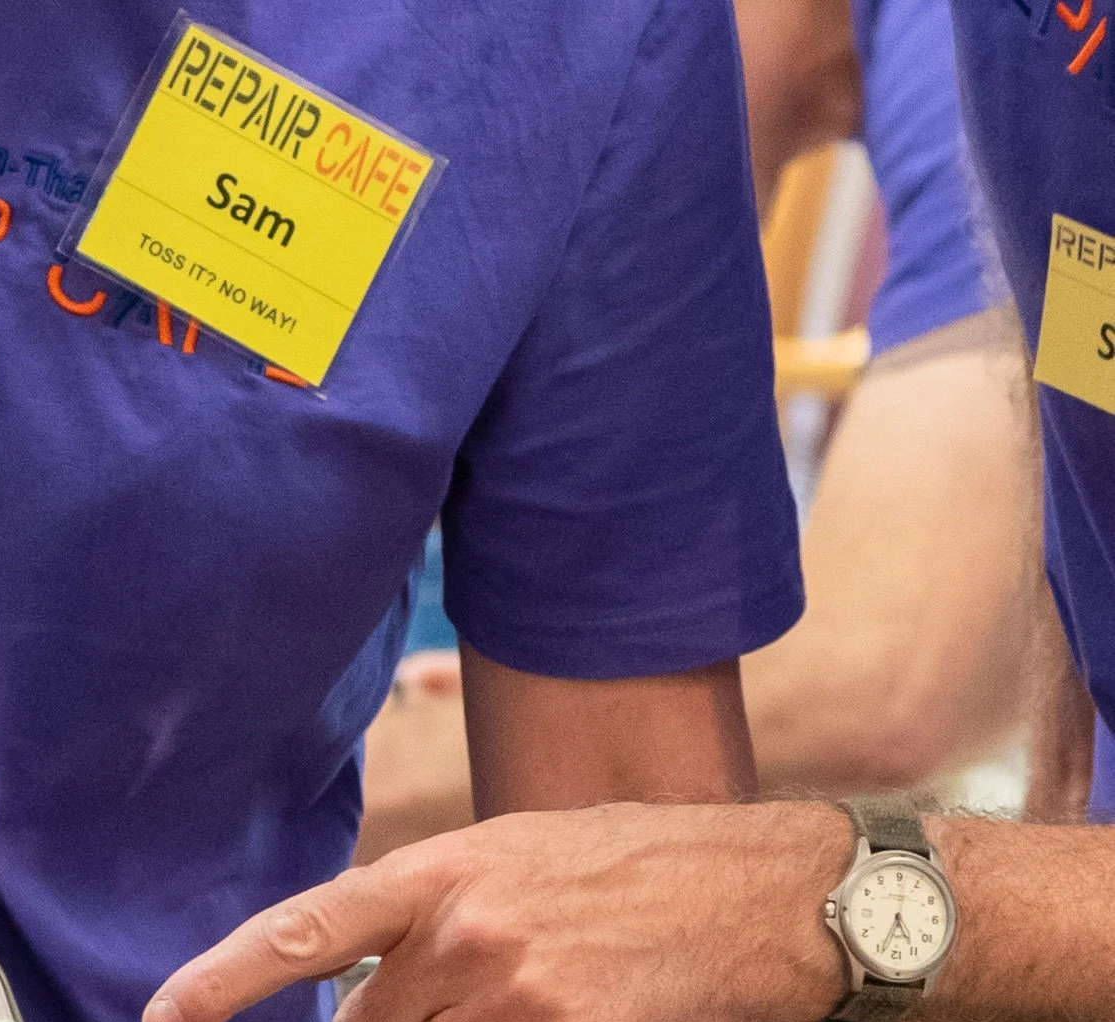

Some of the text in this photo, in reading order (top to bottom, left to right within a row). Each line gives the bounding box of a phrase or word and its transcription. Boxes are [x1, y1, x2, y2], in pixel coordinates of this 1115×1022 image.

[167, 37, 421, 216] REPAIR CAFE
[205, 173, 296, 247] Sam
[140, 233, 298, 334] TOSS IT? NO WAY!
